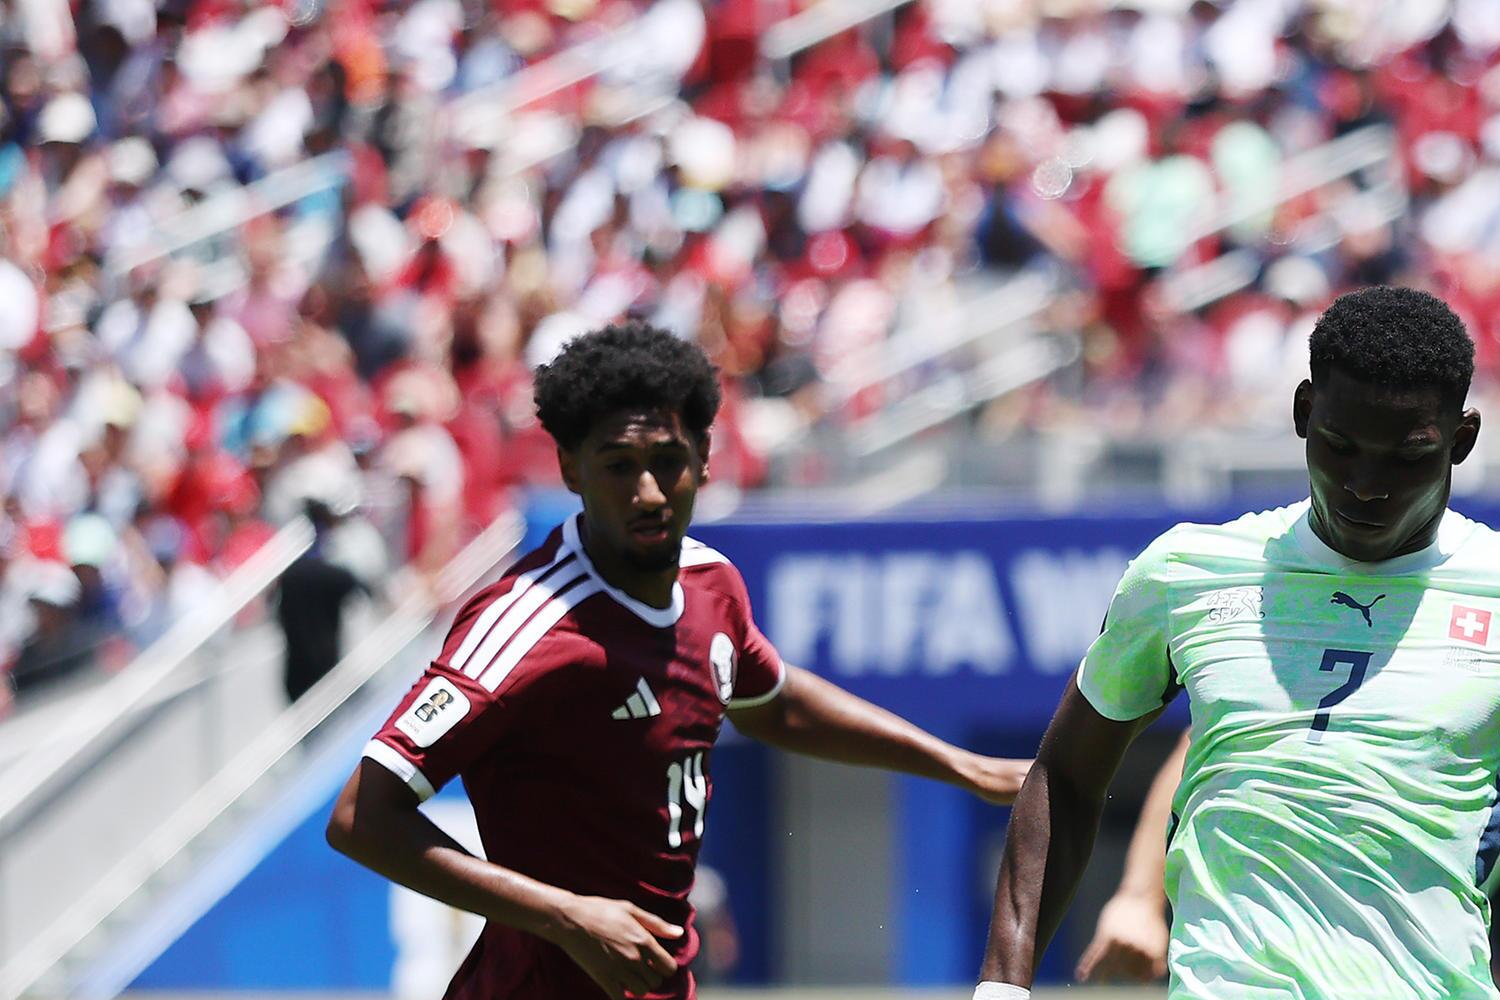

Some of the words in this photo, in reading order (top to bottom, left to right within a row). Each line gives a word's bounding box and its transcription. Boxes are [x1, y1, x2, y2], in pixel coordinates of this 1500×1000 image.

[767, 546, 1014, 676] FIFA
[1305, 648, 1374, 744] 7
[667, 752, 707, 848] 14
